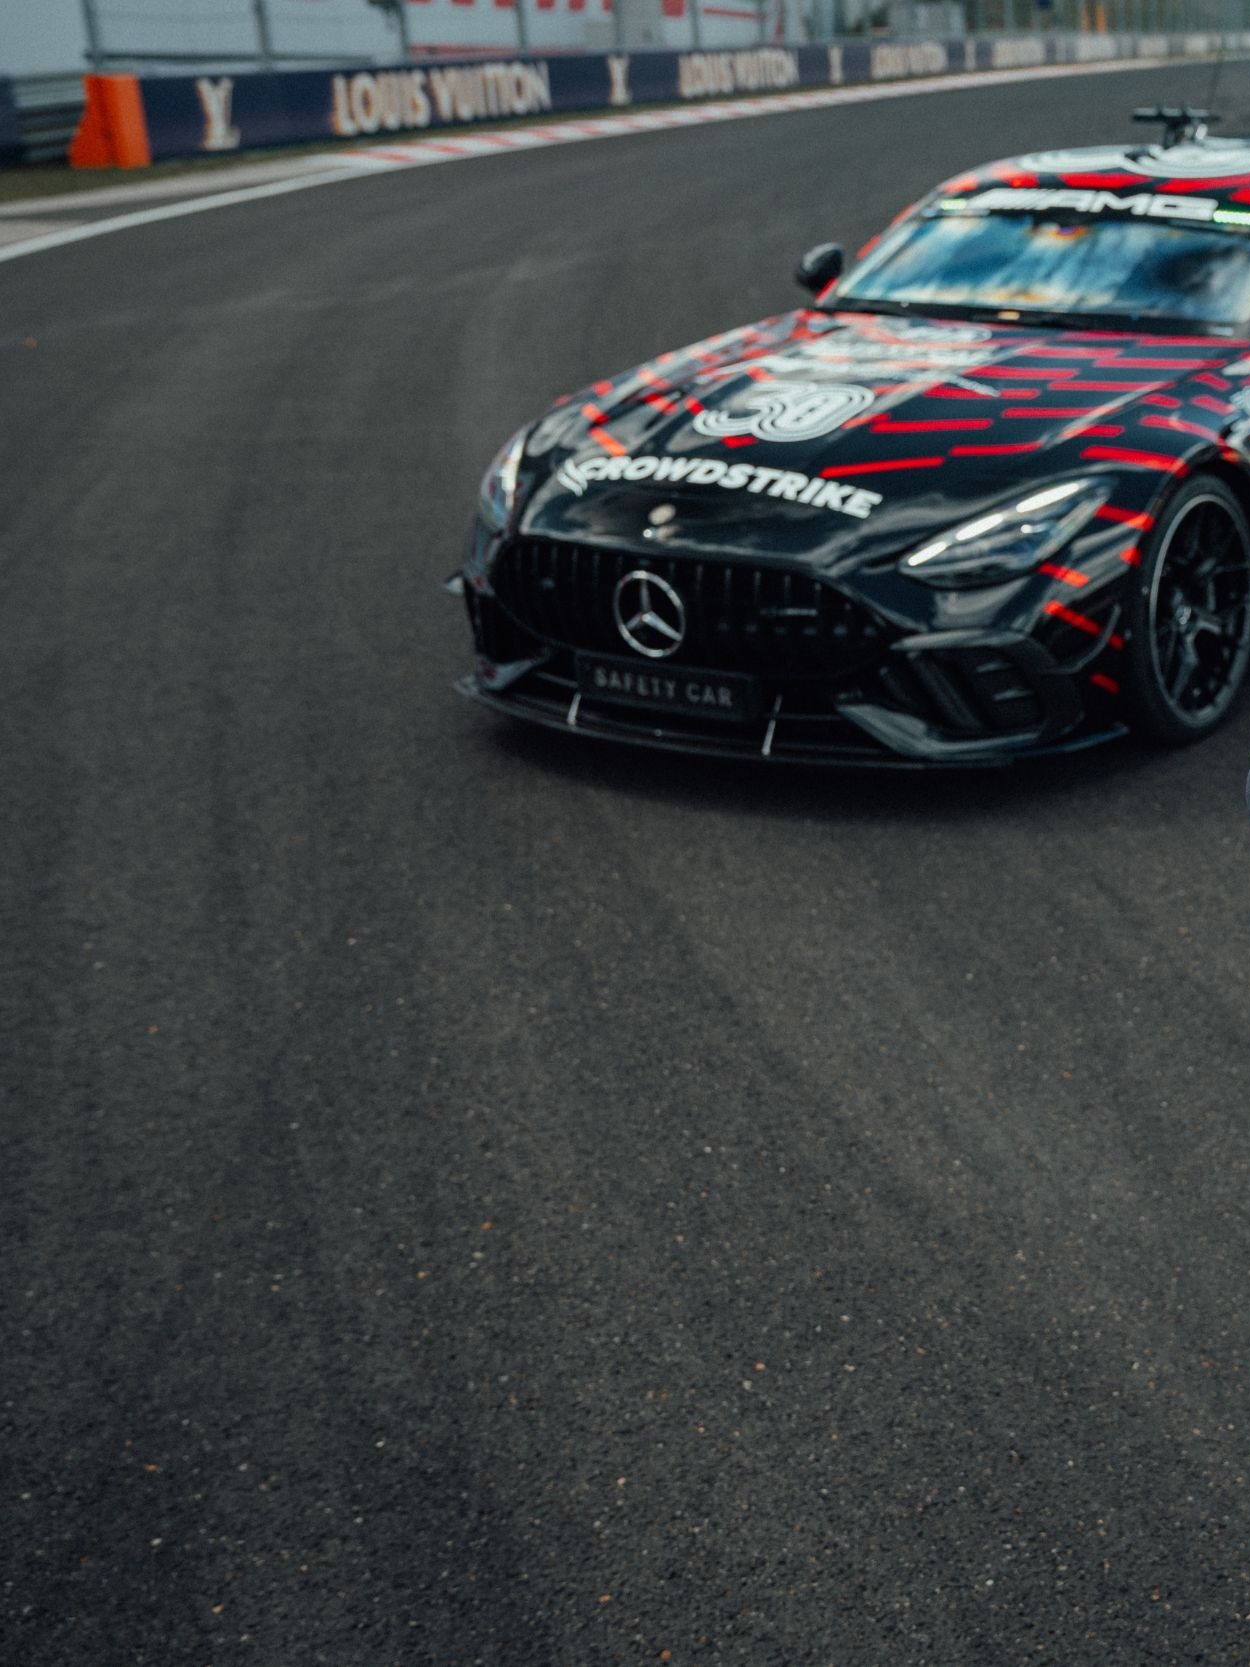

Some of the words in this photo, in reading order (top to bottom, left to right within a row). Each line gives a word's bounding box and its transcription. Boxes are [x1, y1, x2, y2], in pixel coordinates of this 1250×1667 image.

[582, 455, 883, 519] CROWDSTRIKE
[593, 667, 677, 699] SAFETY
[685, 681, 733, 707] CAR
